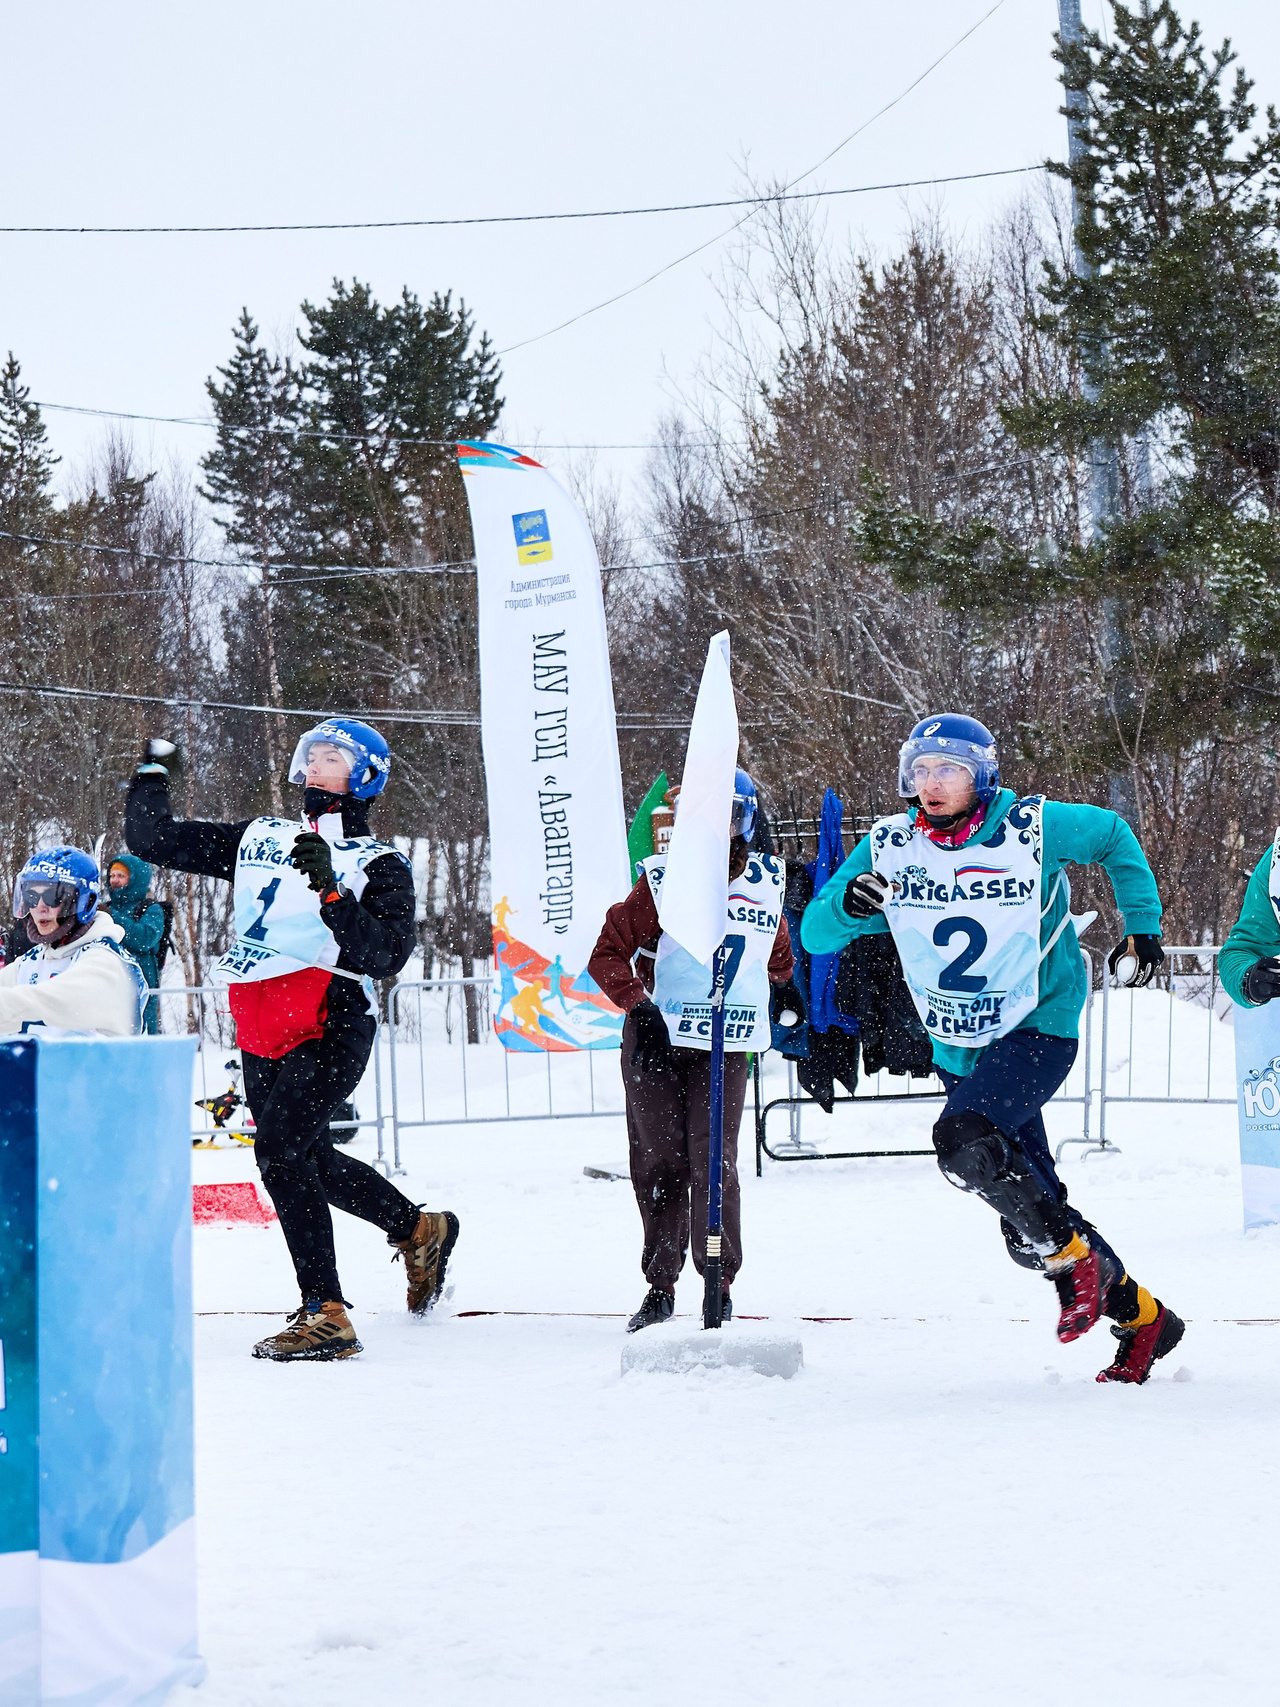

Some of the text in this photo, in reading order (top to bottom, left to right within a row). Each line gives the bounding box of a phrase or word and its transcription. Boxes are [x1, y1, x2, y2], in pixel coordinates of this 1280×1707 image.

[510, 573, 571, 594] Администрация
[504, 589, 577, 611] города Мурманска
[531, 629, 574, 935] МАУ ГСЦ «Авангард»
[243, 877, 282, 942] 1
[707, 934, 746, 998] 7
[932, 915, 988, 993] 2
[958, 996, 1006, 1017] ТОЛК
[678, 1020, 755, 1039] В СЕГЕ
[926, 1008, 1002, 1034] В СНЕГЕ
